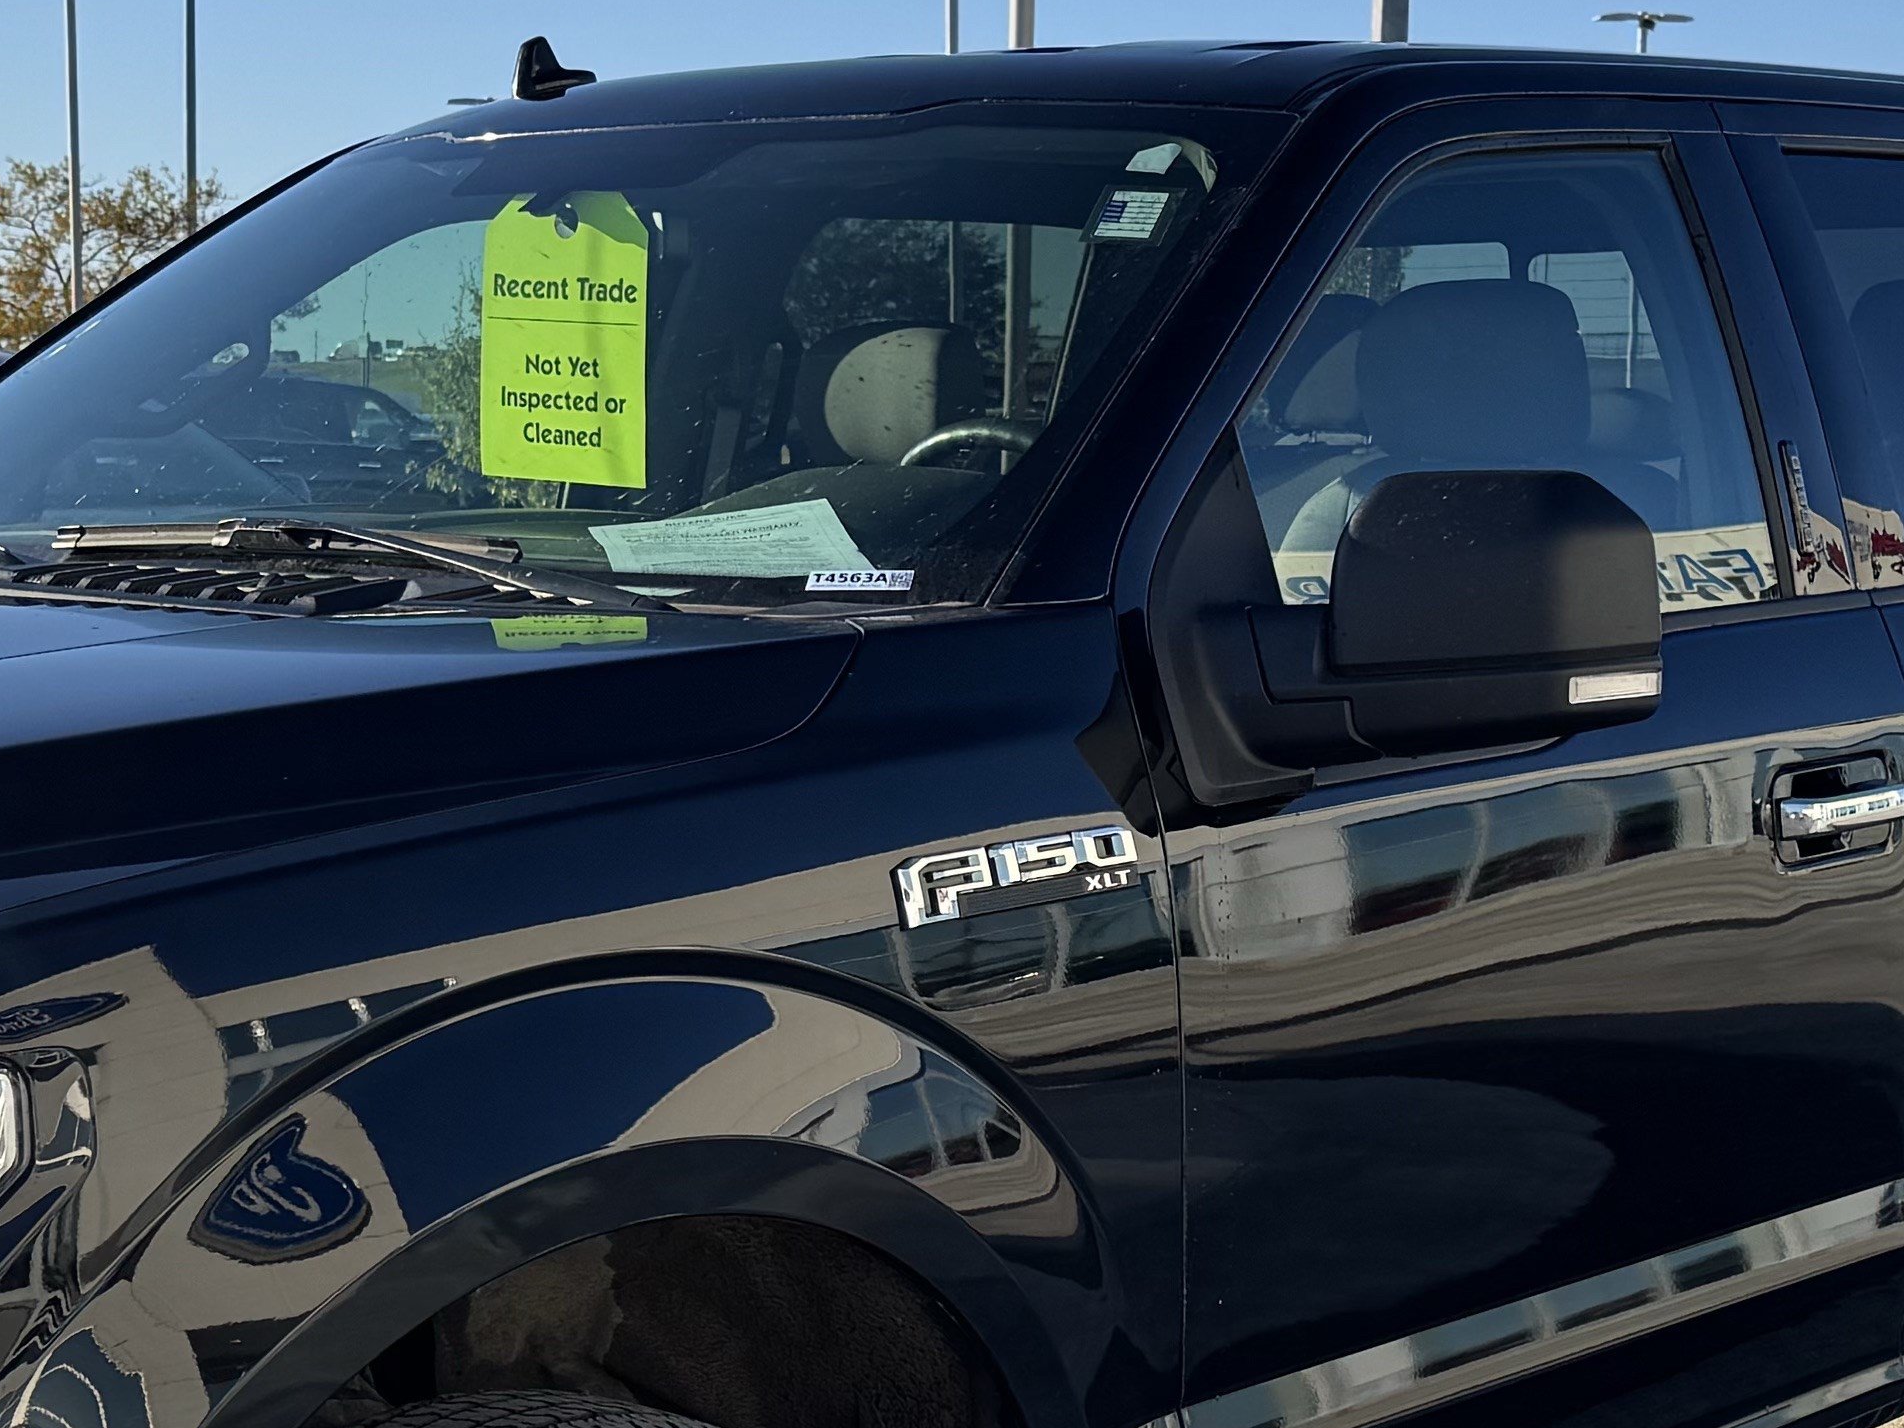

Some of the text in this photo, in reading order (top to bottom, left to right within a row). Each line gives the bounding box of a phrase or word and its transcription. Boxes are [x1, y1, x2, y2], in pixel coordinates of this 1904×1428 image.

[492, 273, 638, 304] Recent Trade
[525, 353, 600, 379] Not Yet
[501, 385, 627, 414] Inspected or
[523, 422, 602, 448] Cleaned
[812, 572, 889, 585] T4563A
[1084, 868, 1131, 892] XLT
